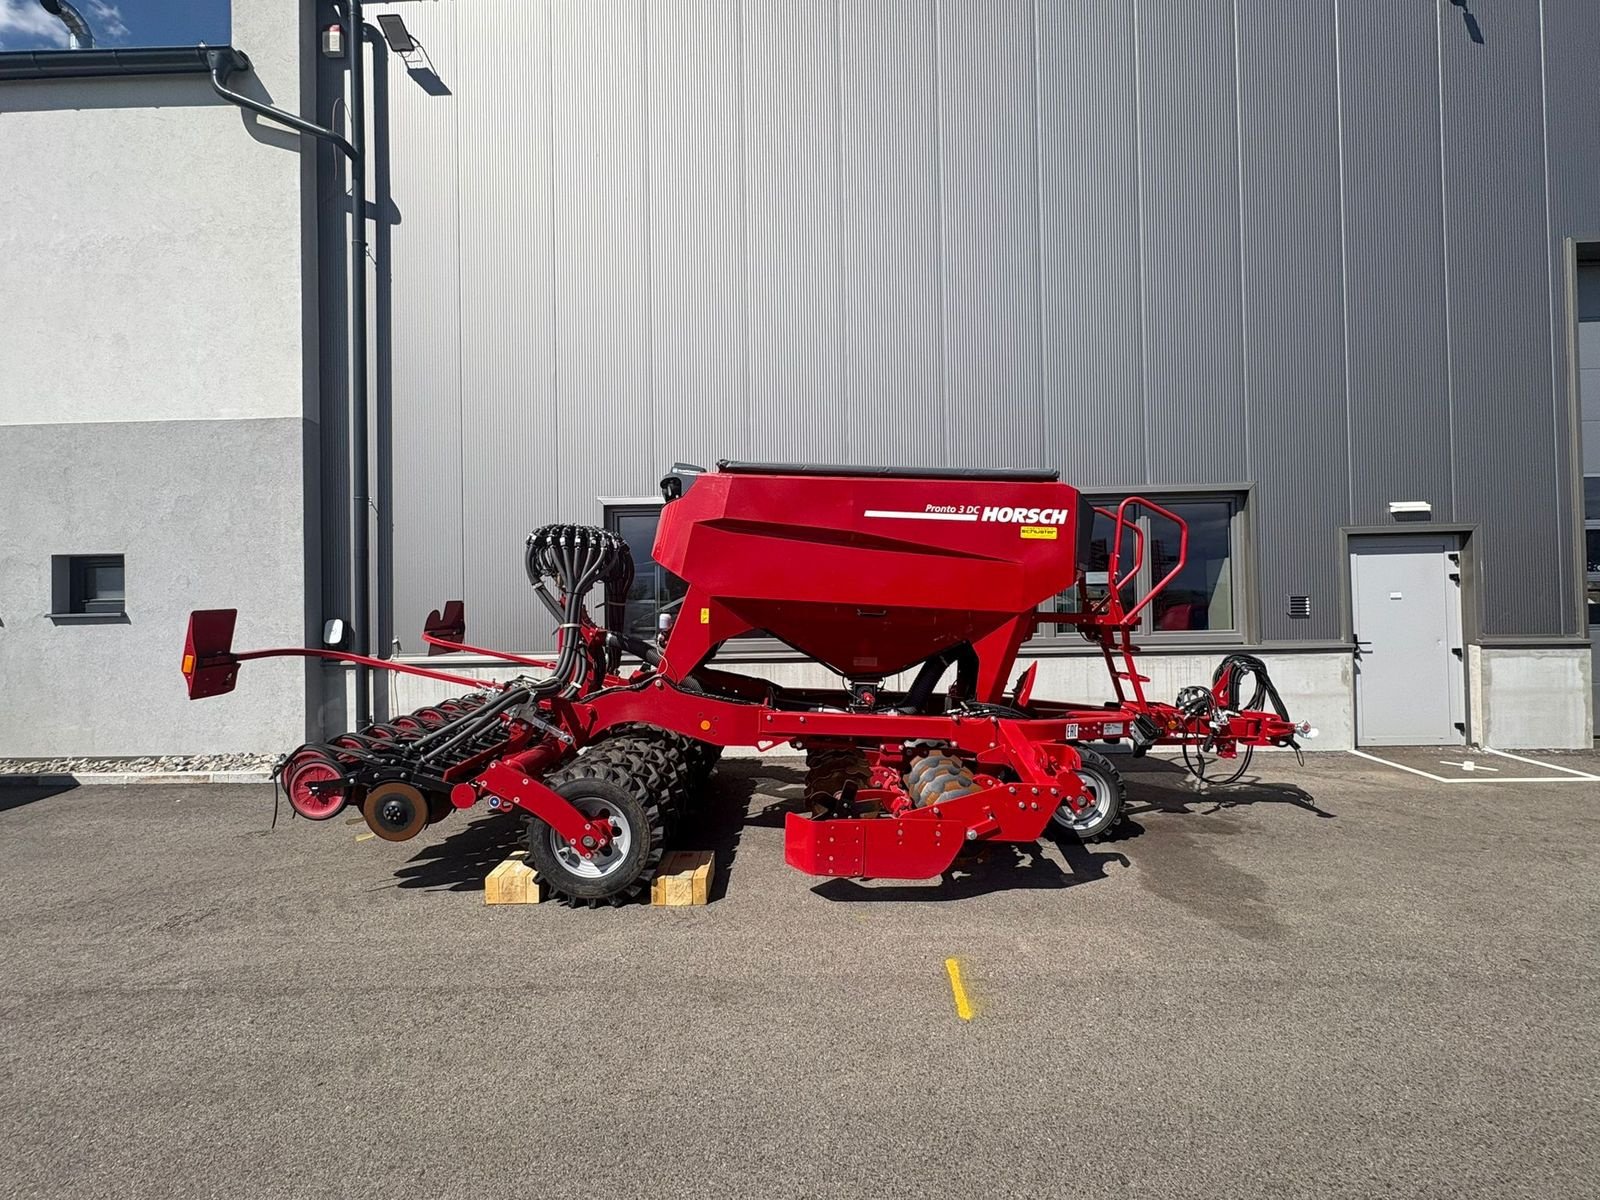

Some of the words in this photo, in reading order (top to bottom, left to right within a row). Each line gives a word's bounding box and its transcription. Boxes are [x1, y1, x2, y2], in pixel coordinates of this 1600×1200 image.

[925, 504, 957, 513] Pronto
[958, 505, 965, 514] 3
[966, 505, 980, 514] DC
[981, 507, 1068, 524] HORSCH
